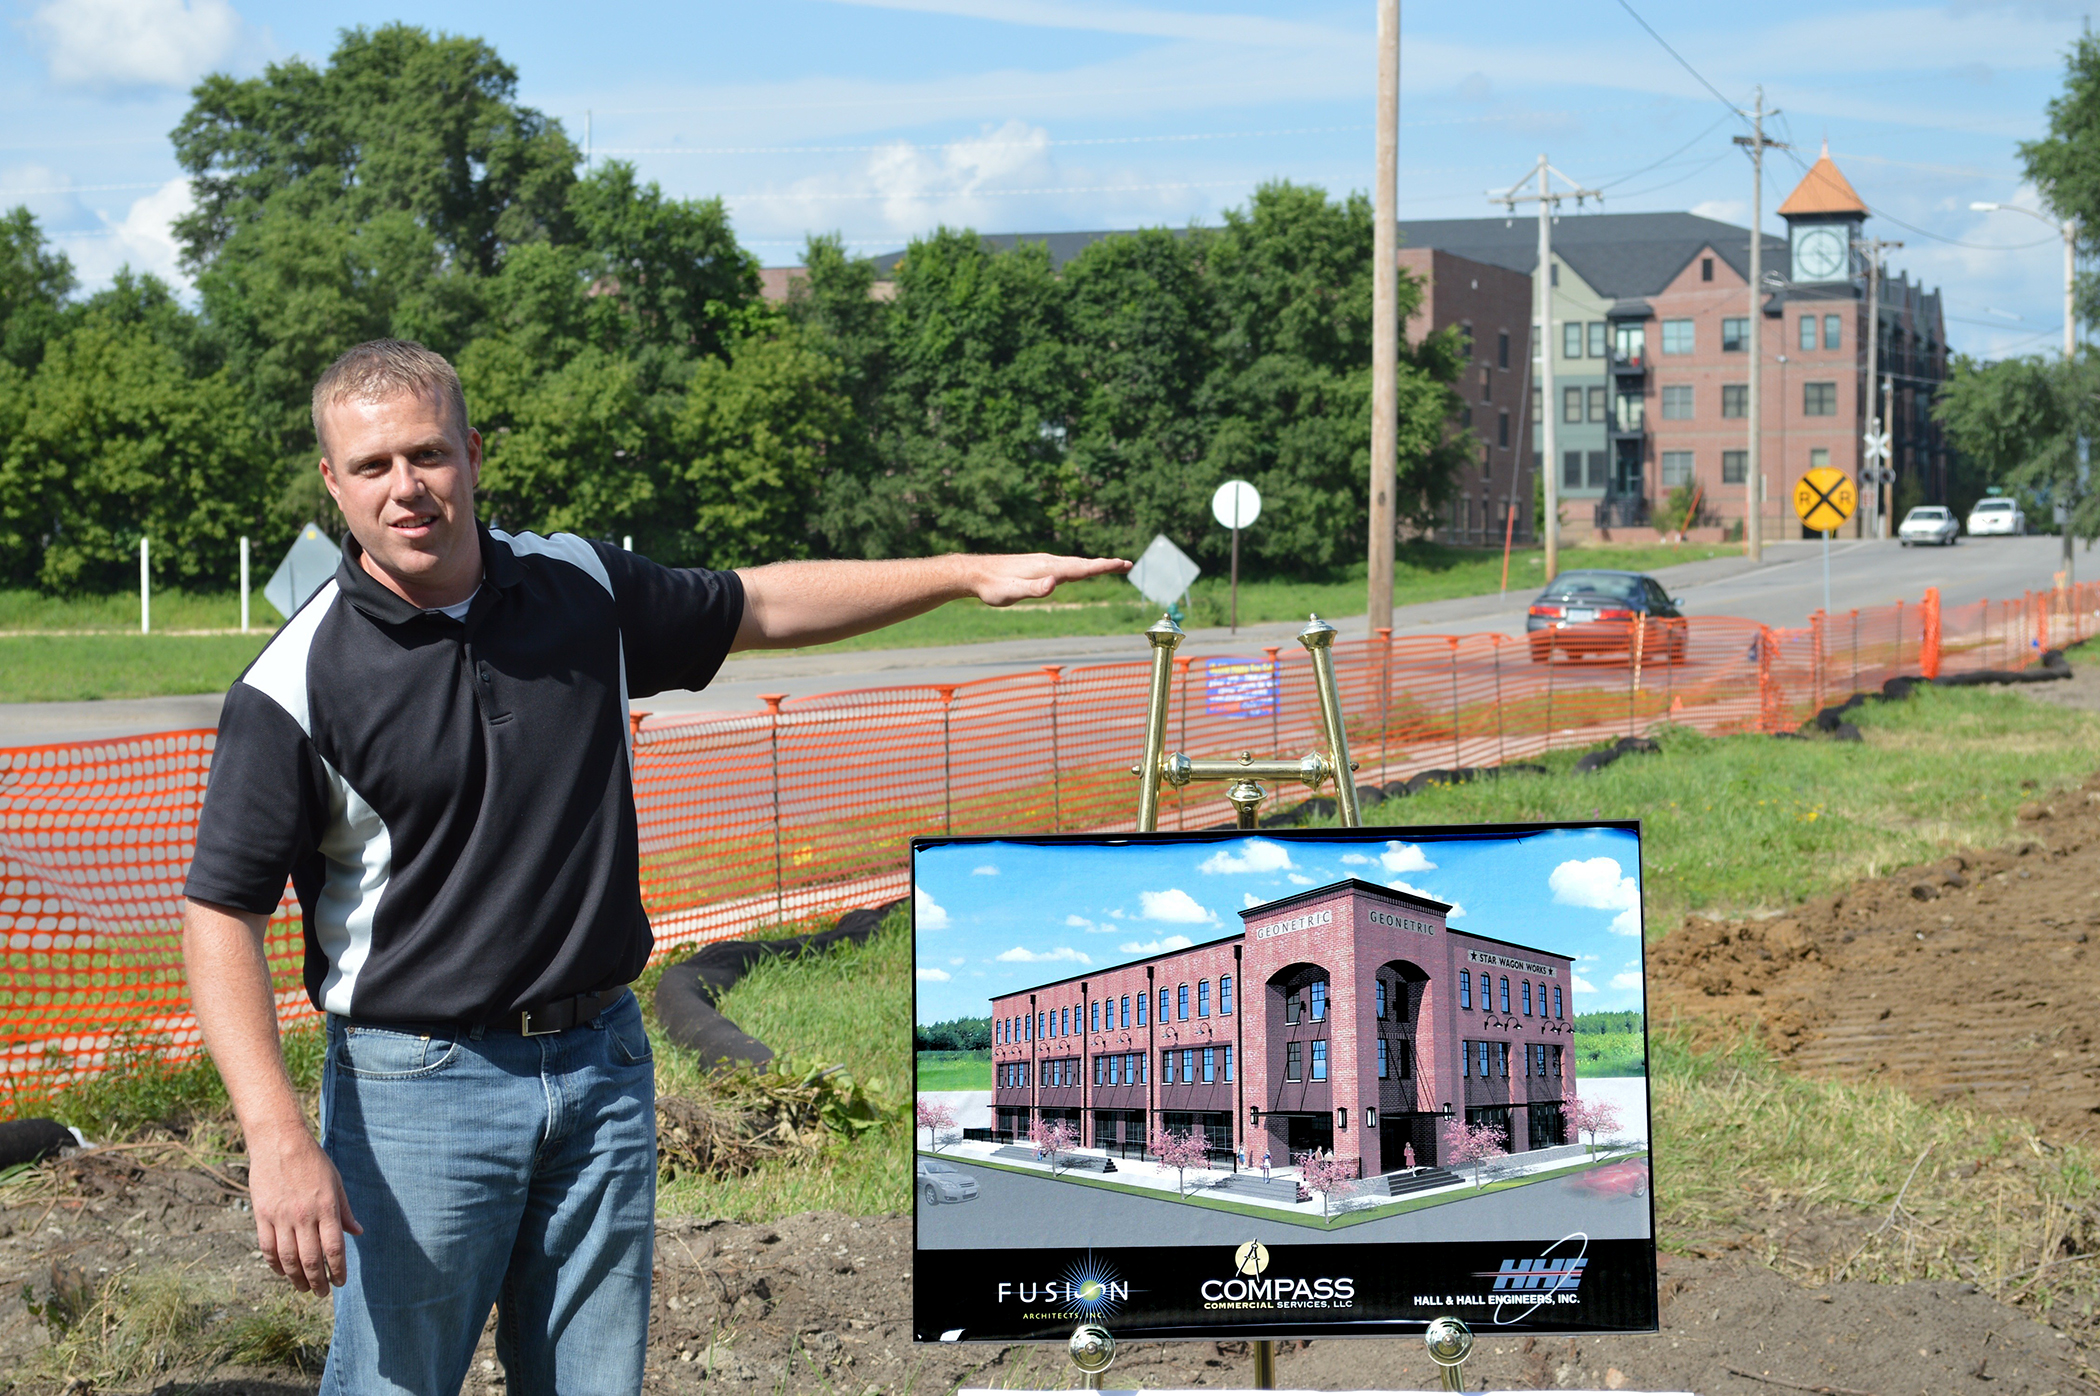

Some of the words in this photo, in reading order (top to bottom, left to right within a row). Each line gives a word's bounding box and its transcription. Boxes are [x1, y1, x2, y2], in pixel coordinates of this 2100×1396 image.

[1257, 911, 1330, 939] GEONETRIC
[1370, 911, 1435, 936] GEONETRIC
[1480, 953, 1497, 964] STAR
[1499, 957, 1524, 970] WAGON
[1526, 963, 1546, 975] WORKS
[1492, 1258, 1589, 1290] HHE
[998, 1280, 1128, 1303] FUSION
[1201, 1277, 1355, 1301] COMPASS
[1414, 1296, 1443, 1306] HALL
[1445, 1296, 1454, 1305] &
[1456, 1295, 1485, 1305] HALL
[1488, 1294, 1555, 1306] ENGINEERS,
[1557, 1294, 1580, 1304] INC.
[1023, 1312, 1082, 1320] ARCHITECTS,
[1204, 1301, 1274, 1309] COMMERCIAL
[1276, 1300, 1330, 1309] SERVICES,
[1333, 1300, 1353, 1308] LLC
